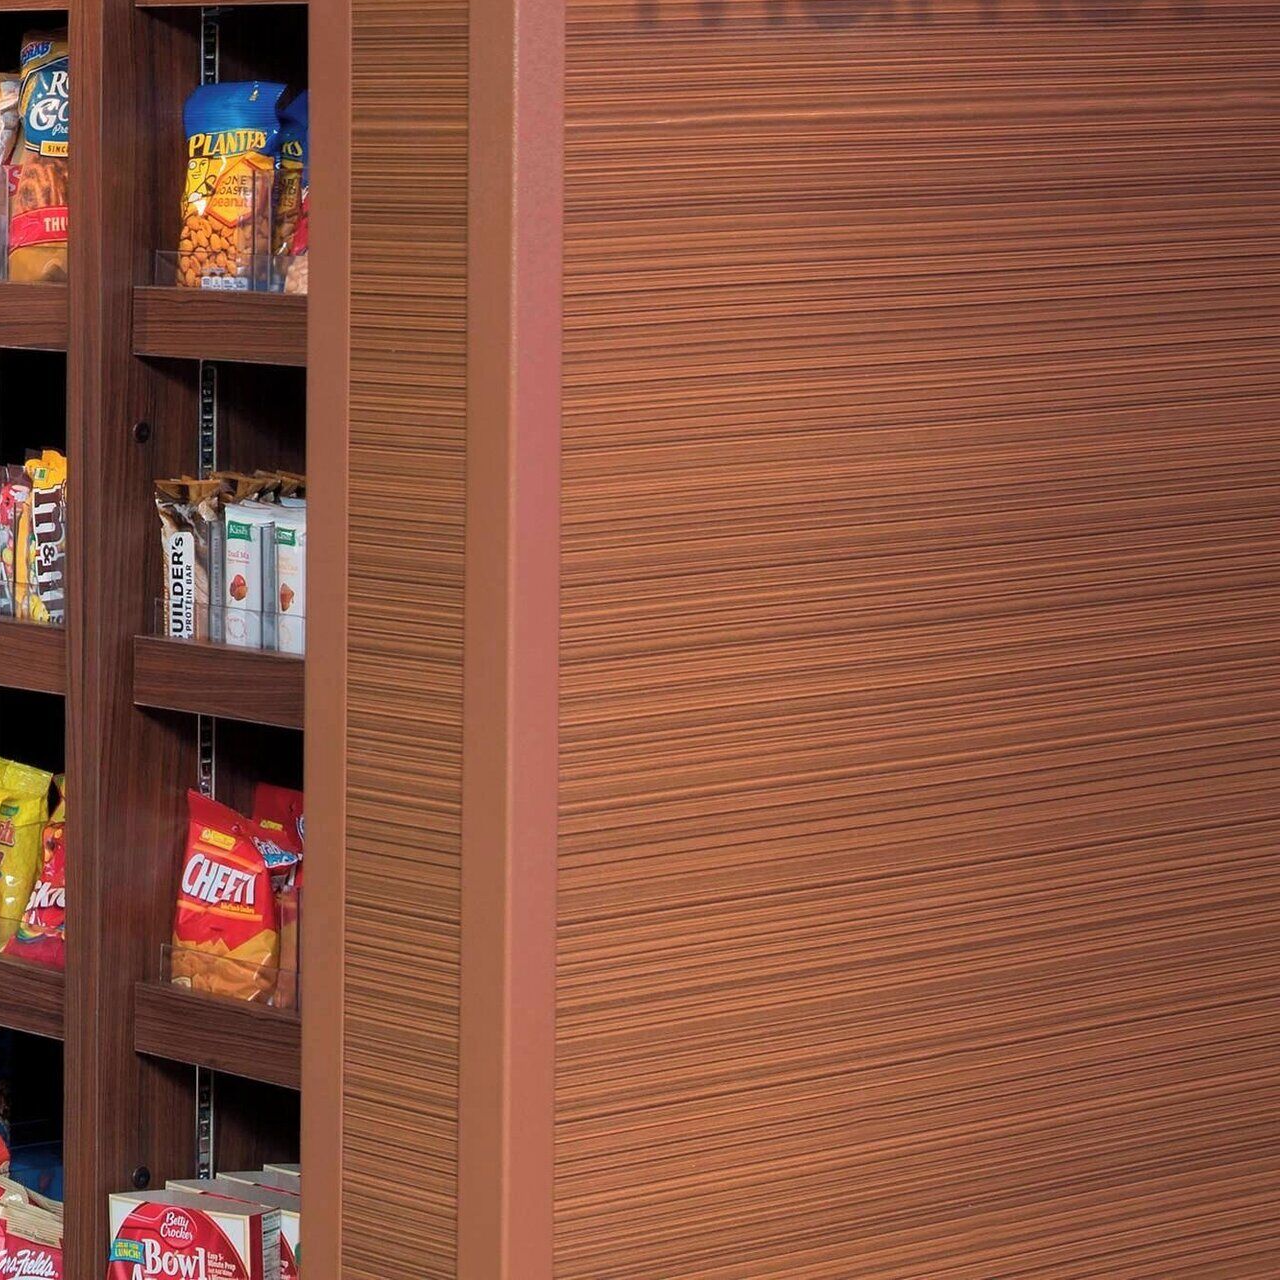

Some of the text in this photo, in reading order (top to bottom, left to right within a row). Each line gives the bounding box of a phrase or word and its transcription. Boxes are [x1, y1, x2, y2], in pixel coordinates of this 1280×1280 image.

[171, 536, 184, 638] UILDER's
[160, 1223, 193, 1240] Crocker
[165, 1211, 191, 1230] Betty
[142, 1237, 206, 1278] Bowl
